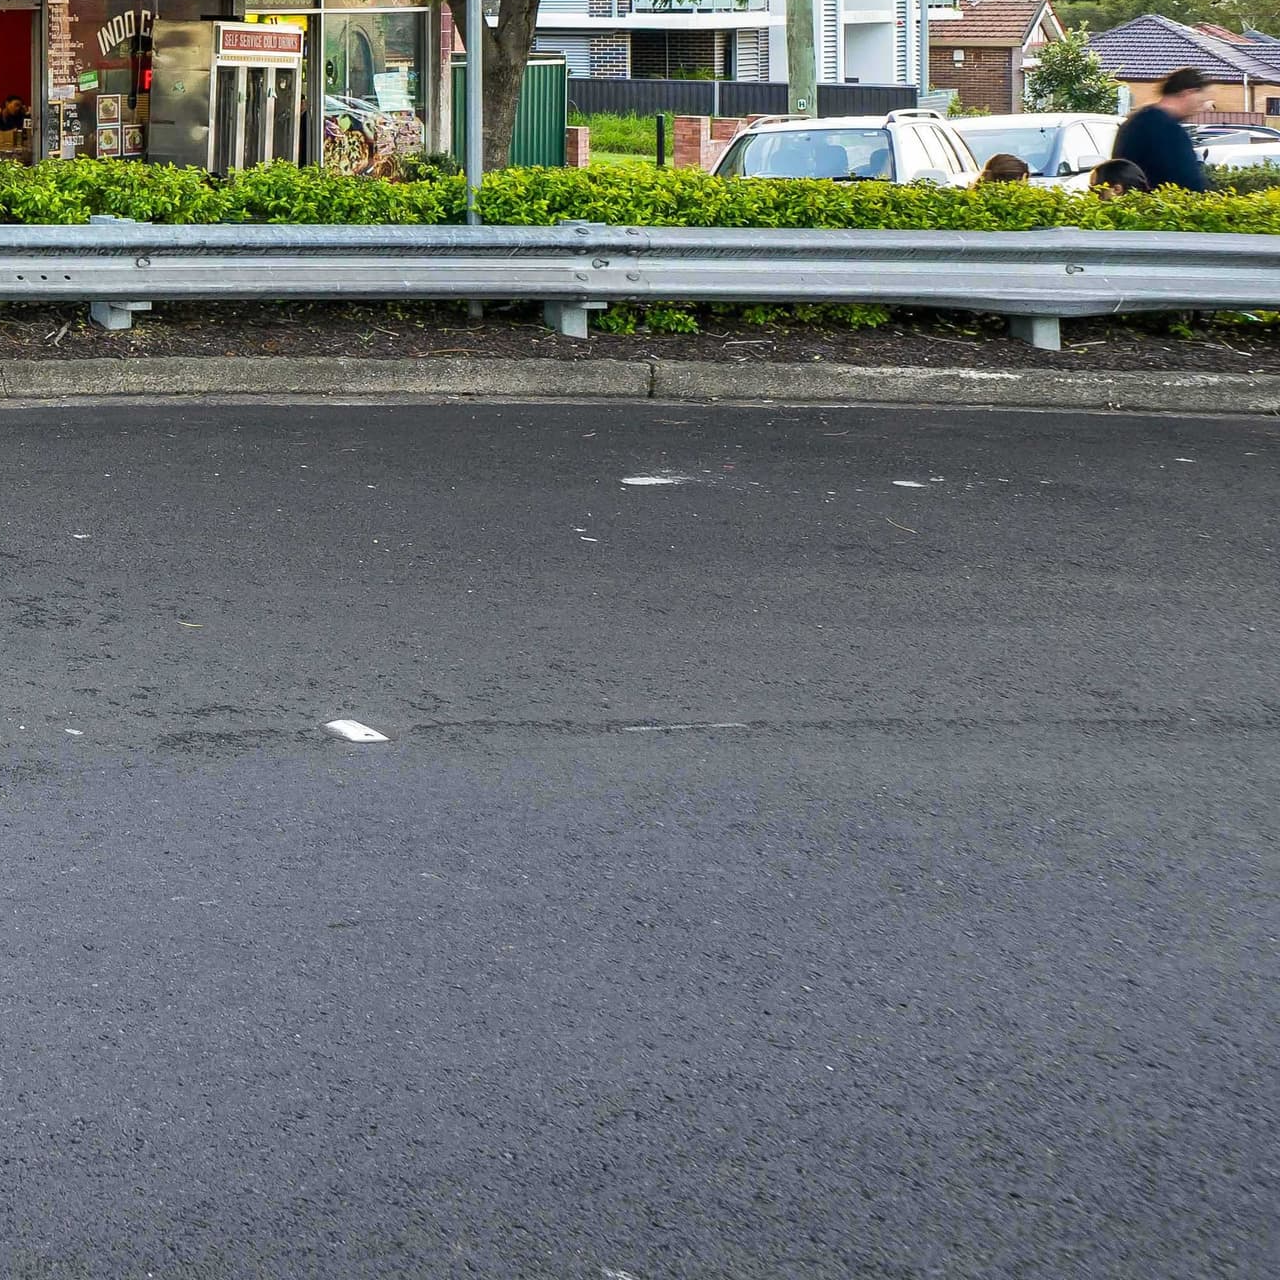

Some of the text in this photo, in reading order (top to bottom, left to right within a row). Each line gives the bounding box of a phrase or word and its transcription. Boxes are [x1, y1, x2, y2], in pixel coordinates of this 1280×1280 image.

[96, 10, 136, 56] INDO
[140, 9, 153, 37] C
[224, 33, 298, 49] SELF SERVICE COLD DRINKS
